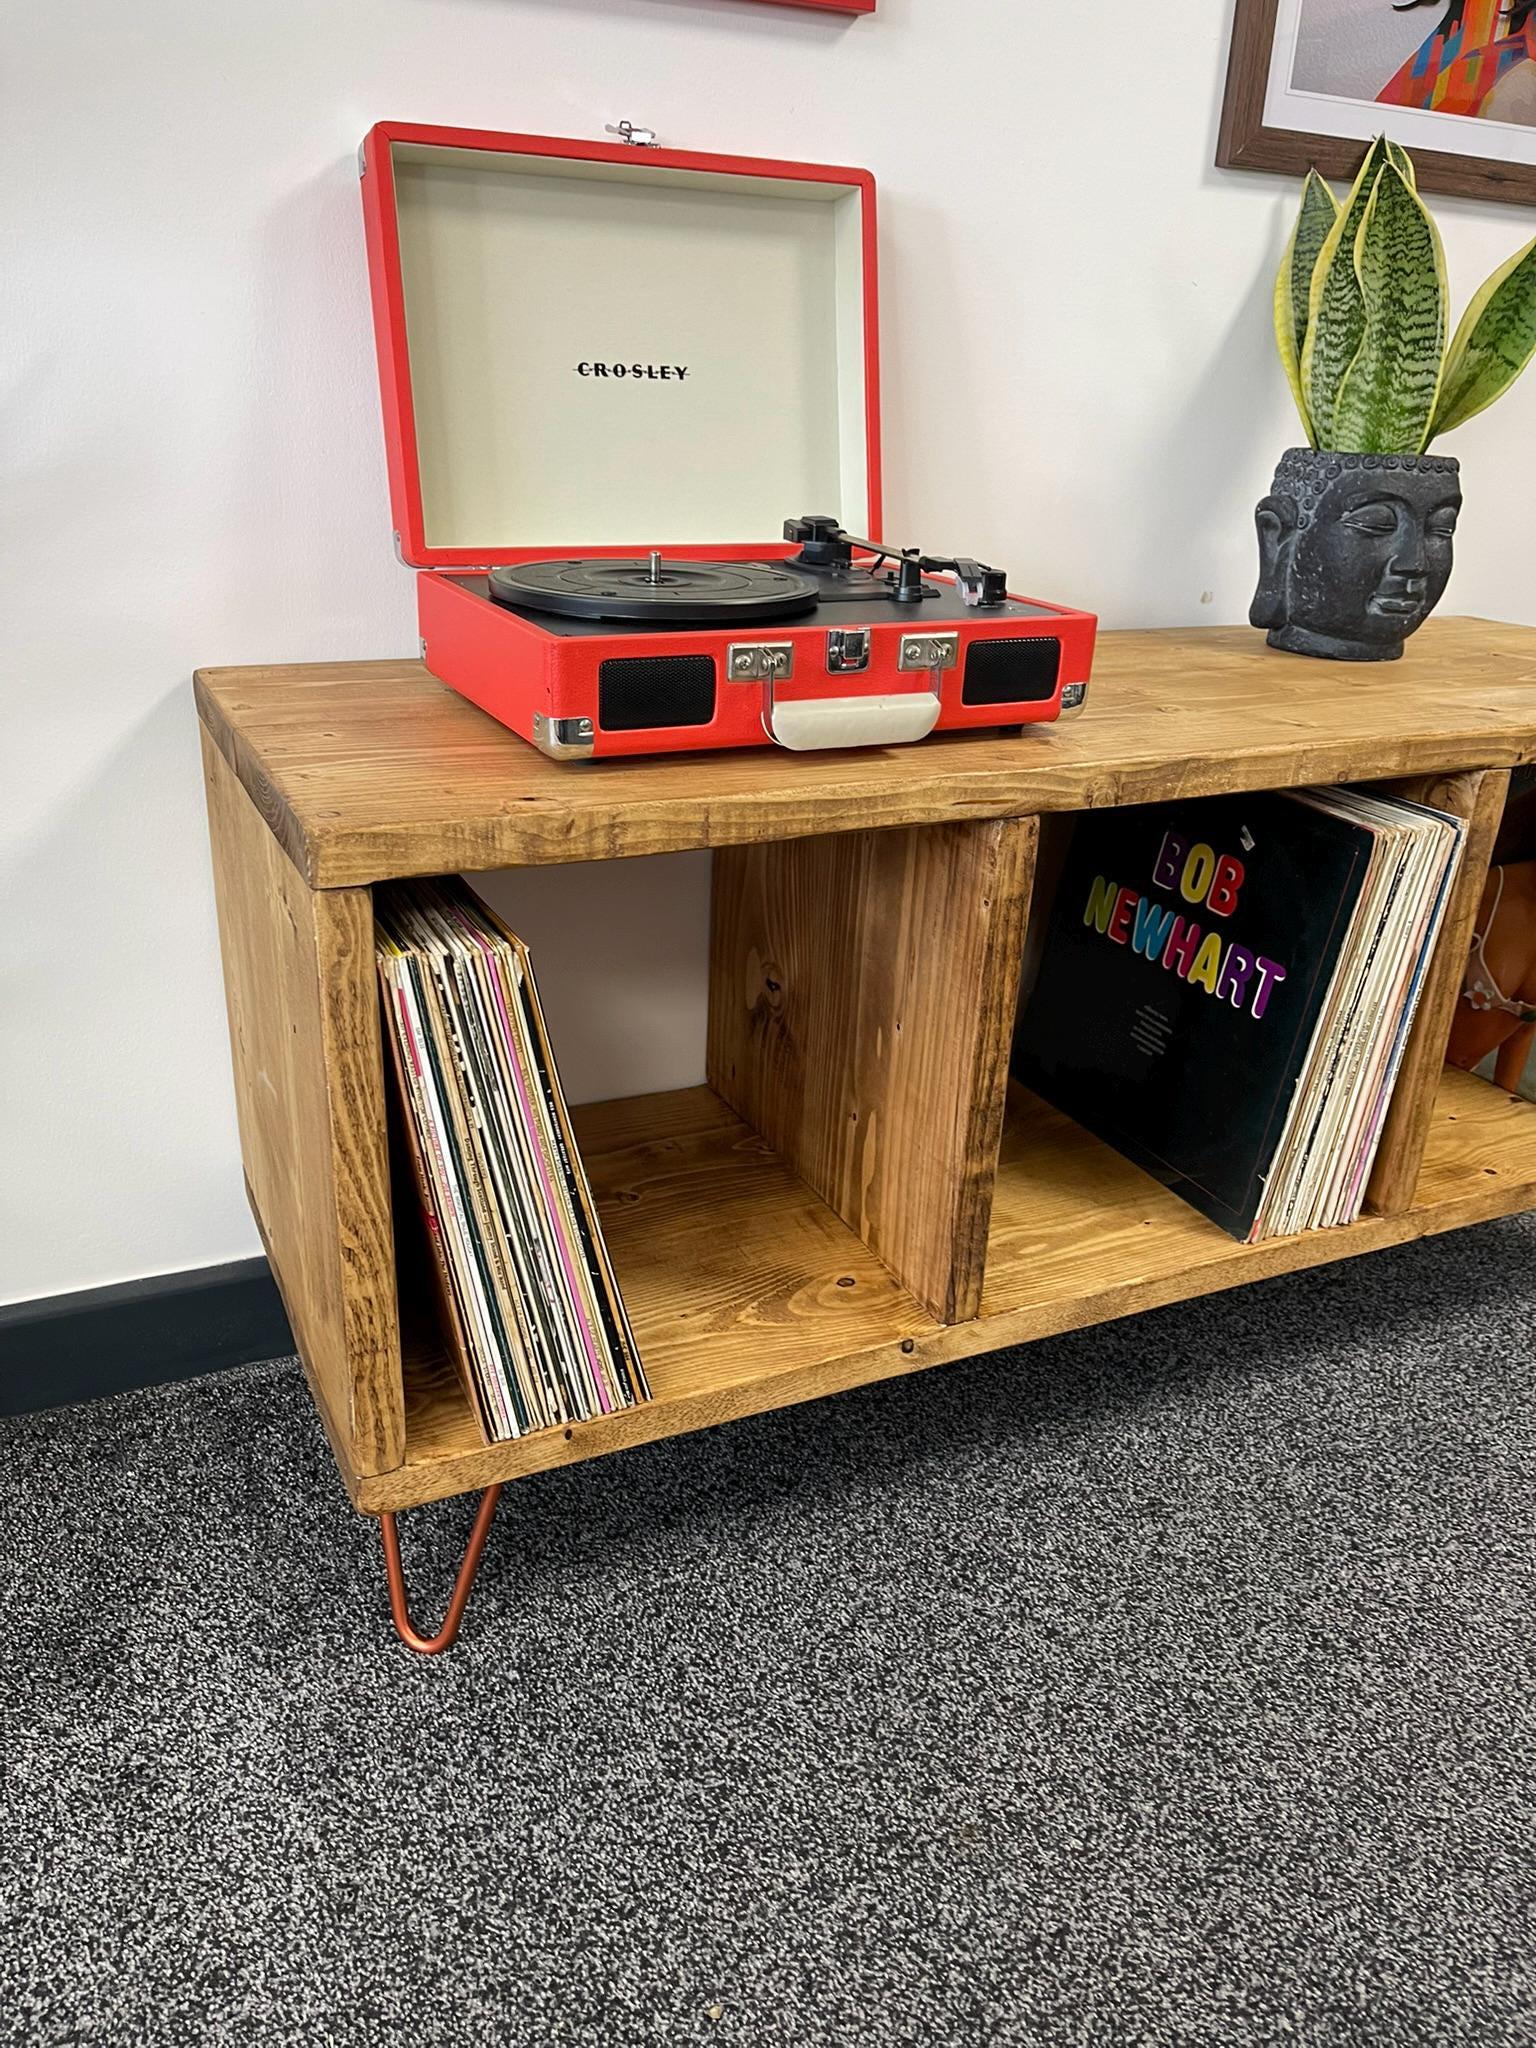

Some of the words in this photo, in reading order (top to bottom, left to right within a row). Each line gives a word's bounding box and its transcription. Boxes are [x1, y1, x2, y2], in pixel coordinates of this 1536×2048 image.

[576, 361, 689, 381] CROSLEY
[1152, 831, 1245, 917] BOB
[1083, 875, 1286, 1019] NEWHART
